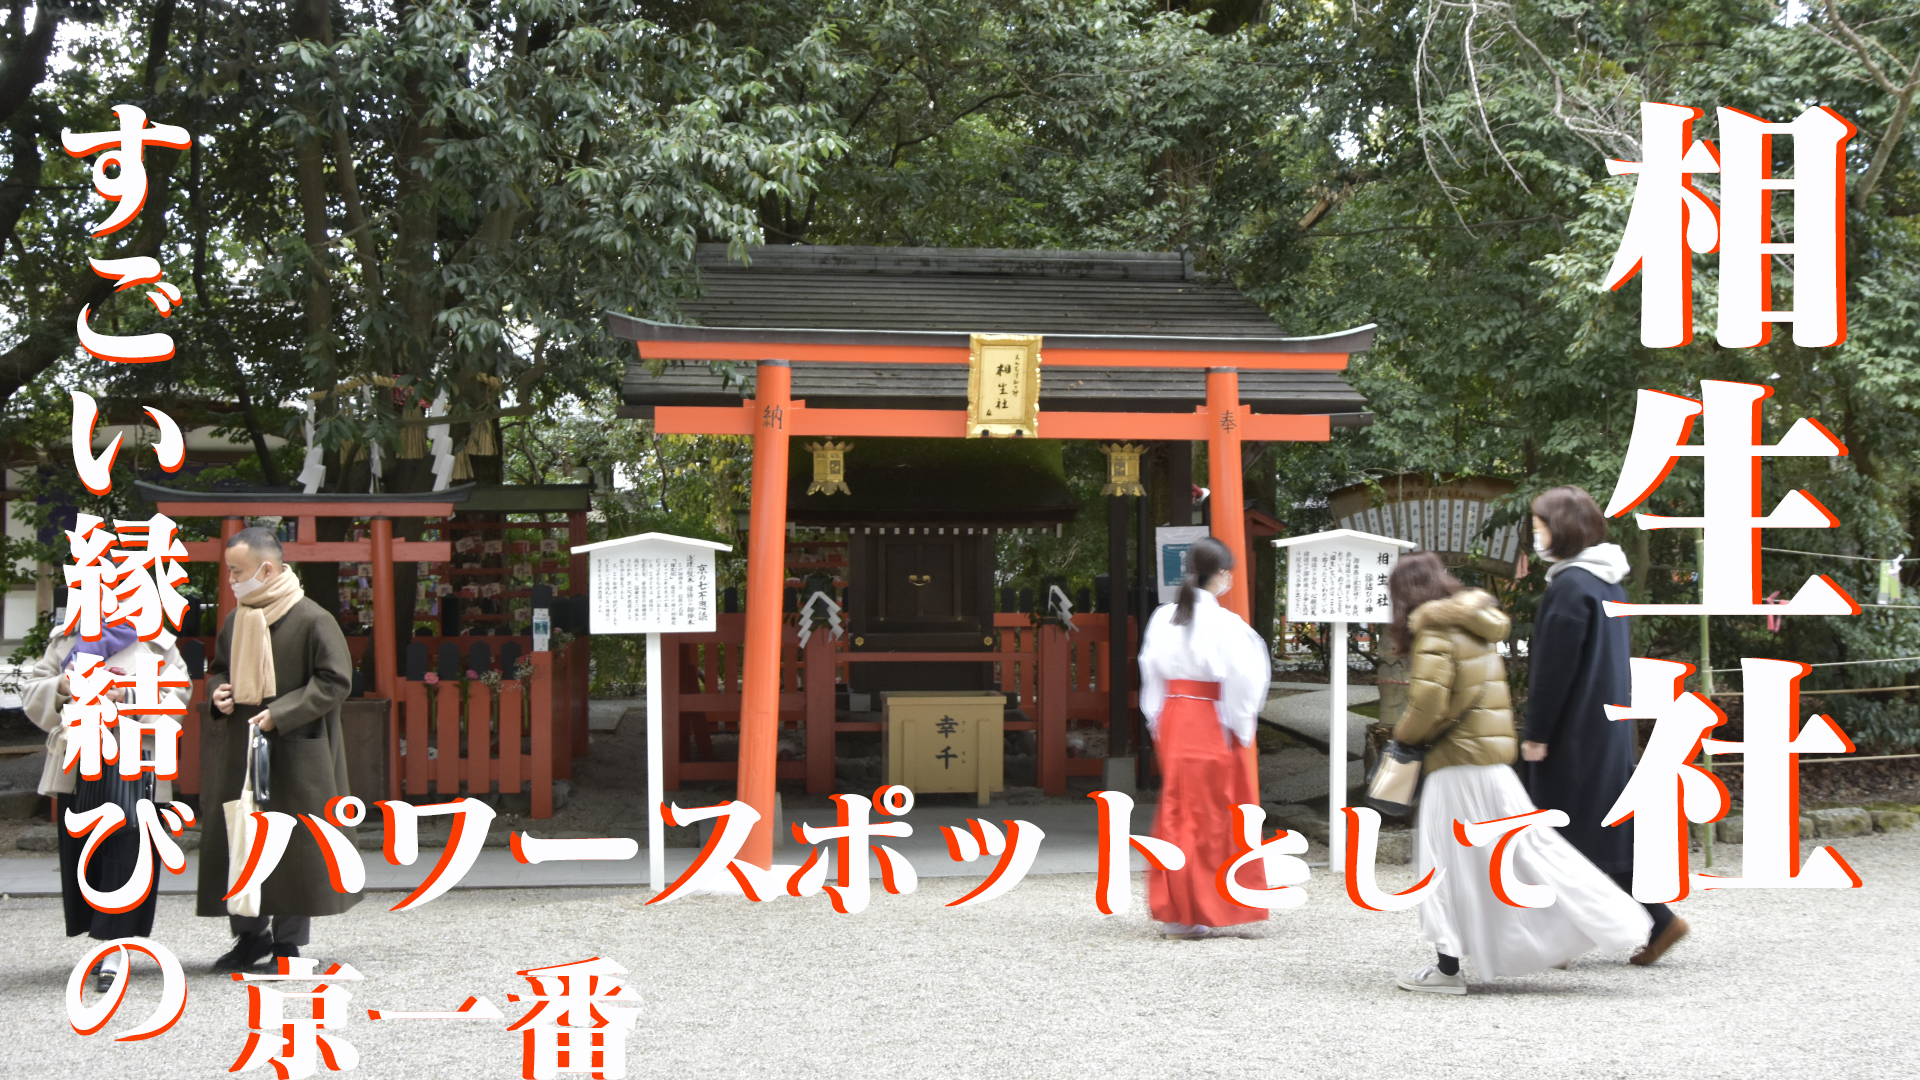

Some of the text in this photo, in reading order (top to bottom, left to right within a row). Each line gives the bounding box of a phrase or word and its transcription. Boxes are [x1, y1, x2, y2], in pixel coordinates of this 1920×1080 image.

[996, 364, 1011, 409] 相生社
[763, 405, 782, 430] 納
[1220, 410, 1237, 434] 奉
[697, 564, 708, 621] 京の七不思議
[1365, 573, 1374, 615] 縁結びの神
[1377, 552, 1389, 608] 相生社
[935, 715, 959, 770] 幸千
